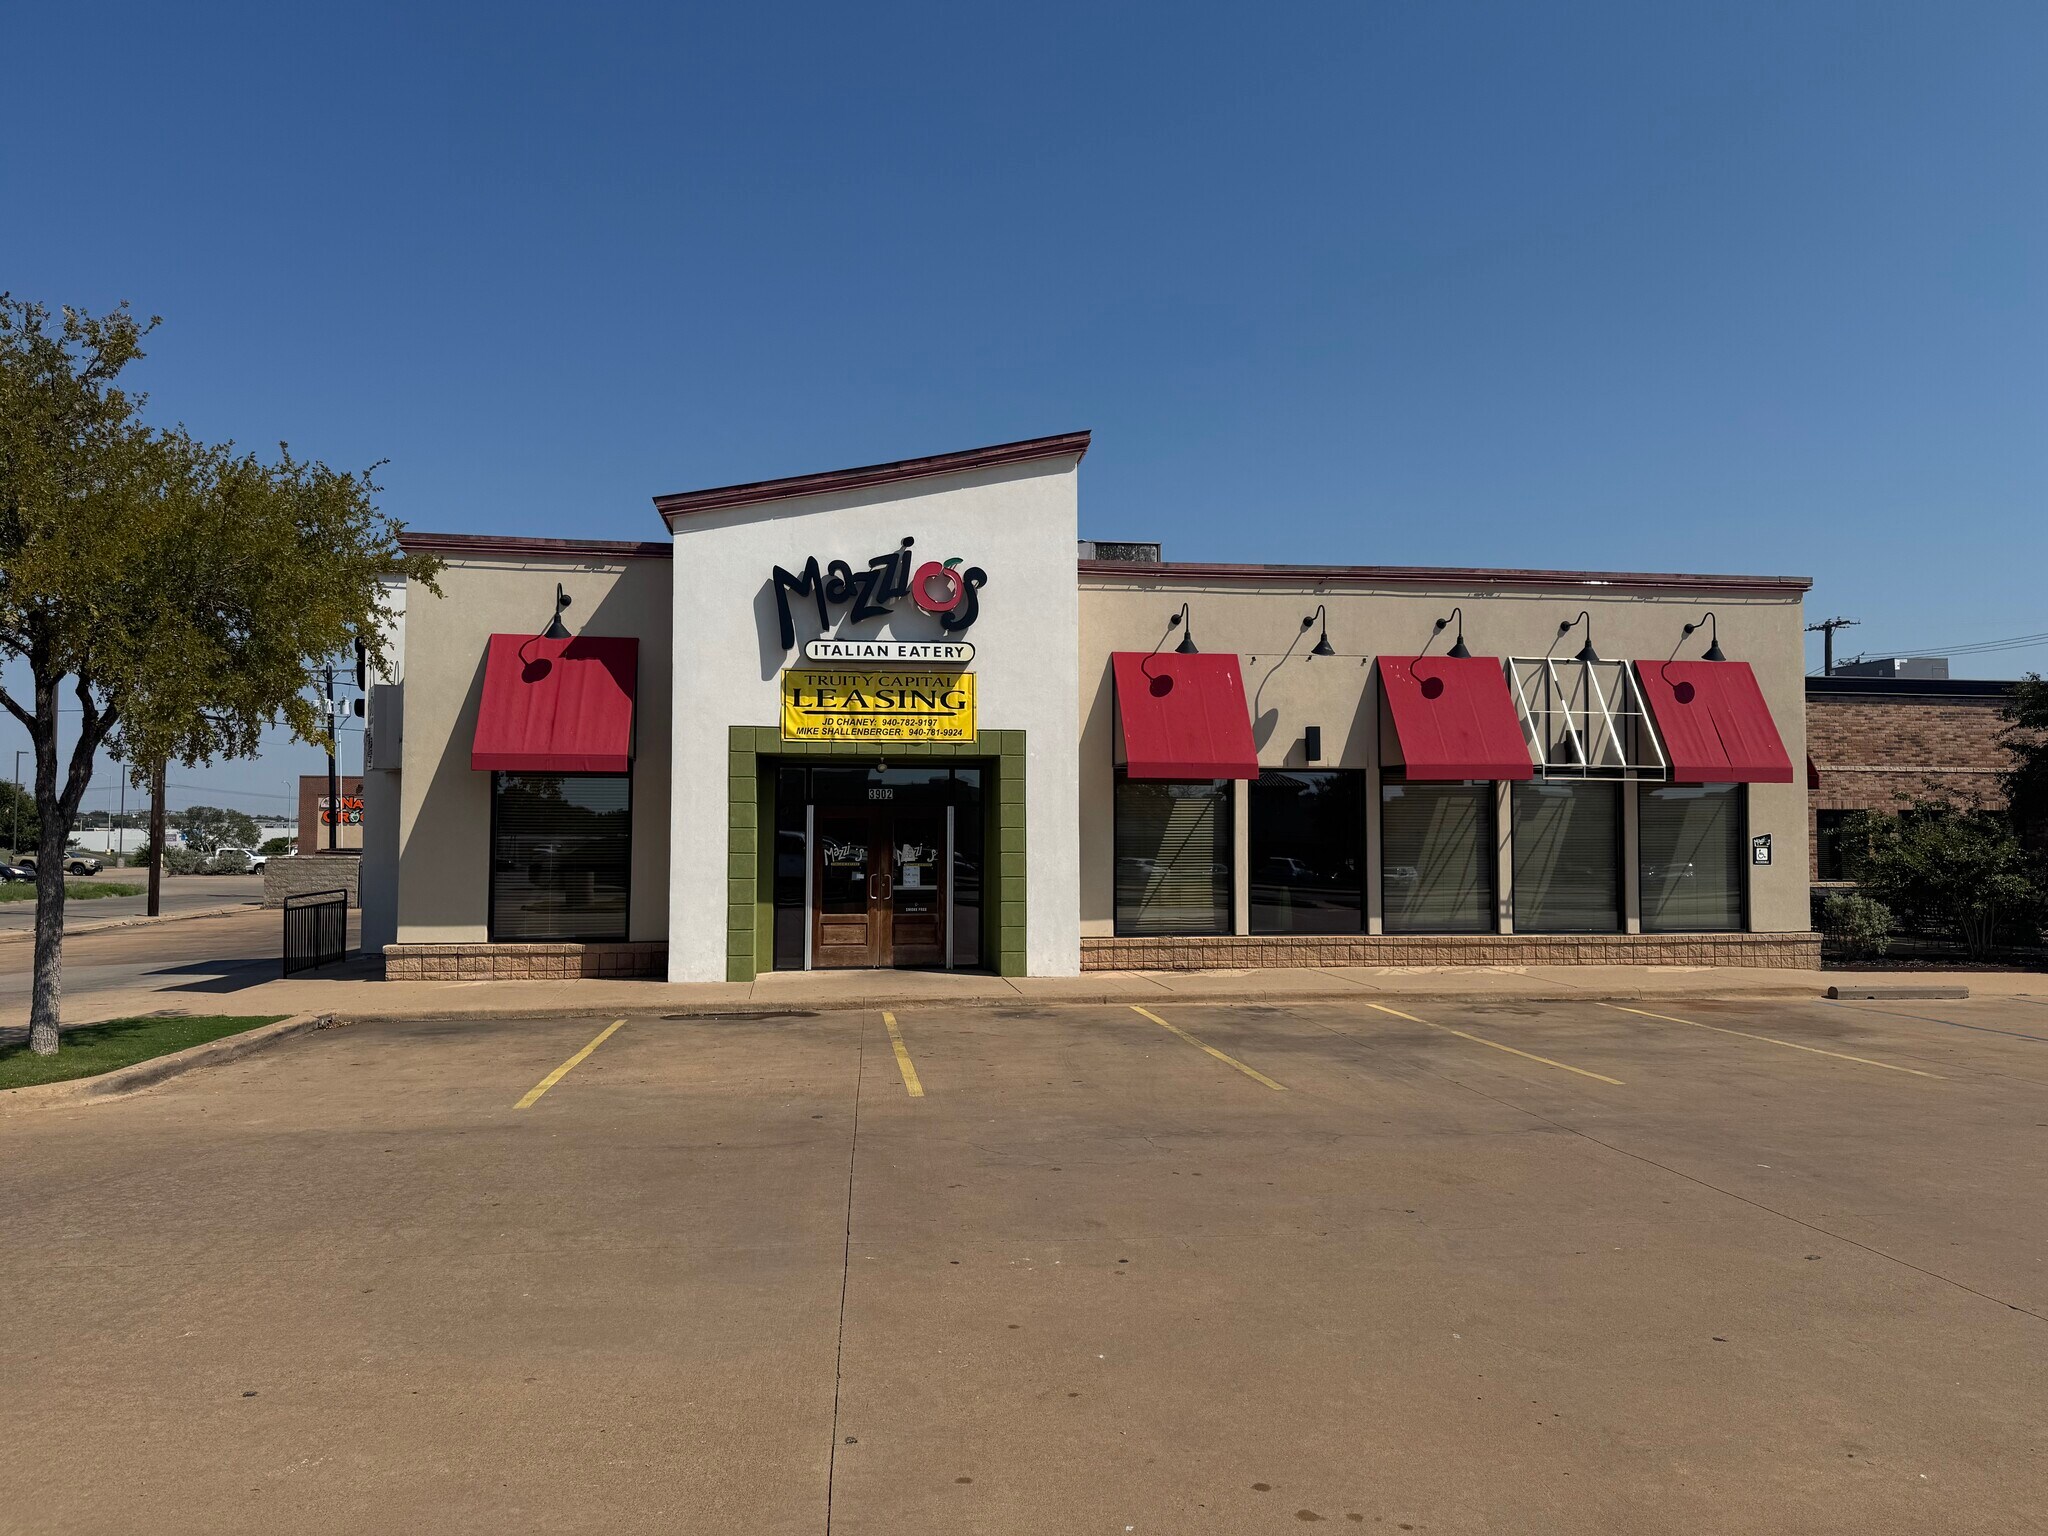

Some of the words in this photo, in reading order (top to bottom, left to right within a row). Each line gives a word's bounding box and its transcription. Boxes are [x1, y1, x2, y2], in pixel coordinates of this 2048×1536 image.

[814, 644, 888, 657] ITALIAN
[898, 645, 964, 658] EATERY
[804, 675, 873, 687] TRUITY
[878, 676, 956, 688] CAPITAL
[793, 688, 966, 710] LEASING
[822, 718, 834, 726] JD
[836, 718, 877, 726] CHANEY:
[882, 718, 938, 727] 940-782-9197
[796, 727, 819, 735] MIKE
[821, 727, 904, 736] SHALLENBERGER:
[908, 728, 963, 737] 940-781-9924
[869, 789, 893, 799] 3902
